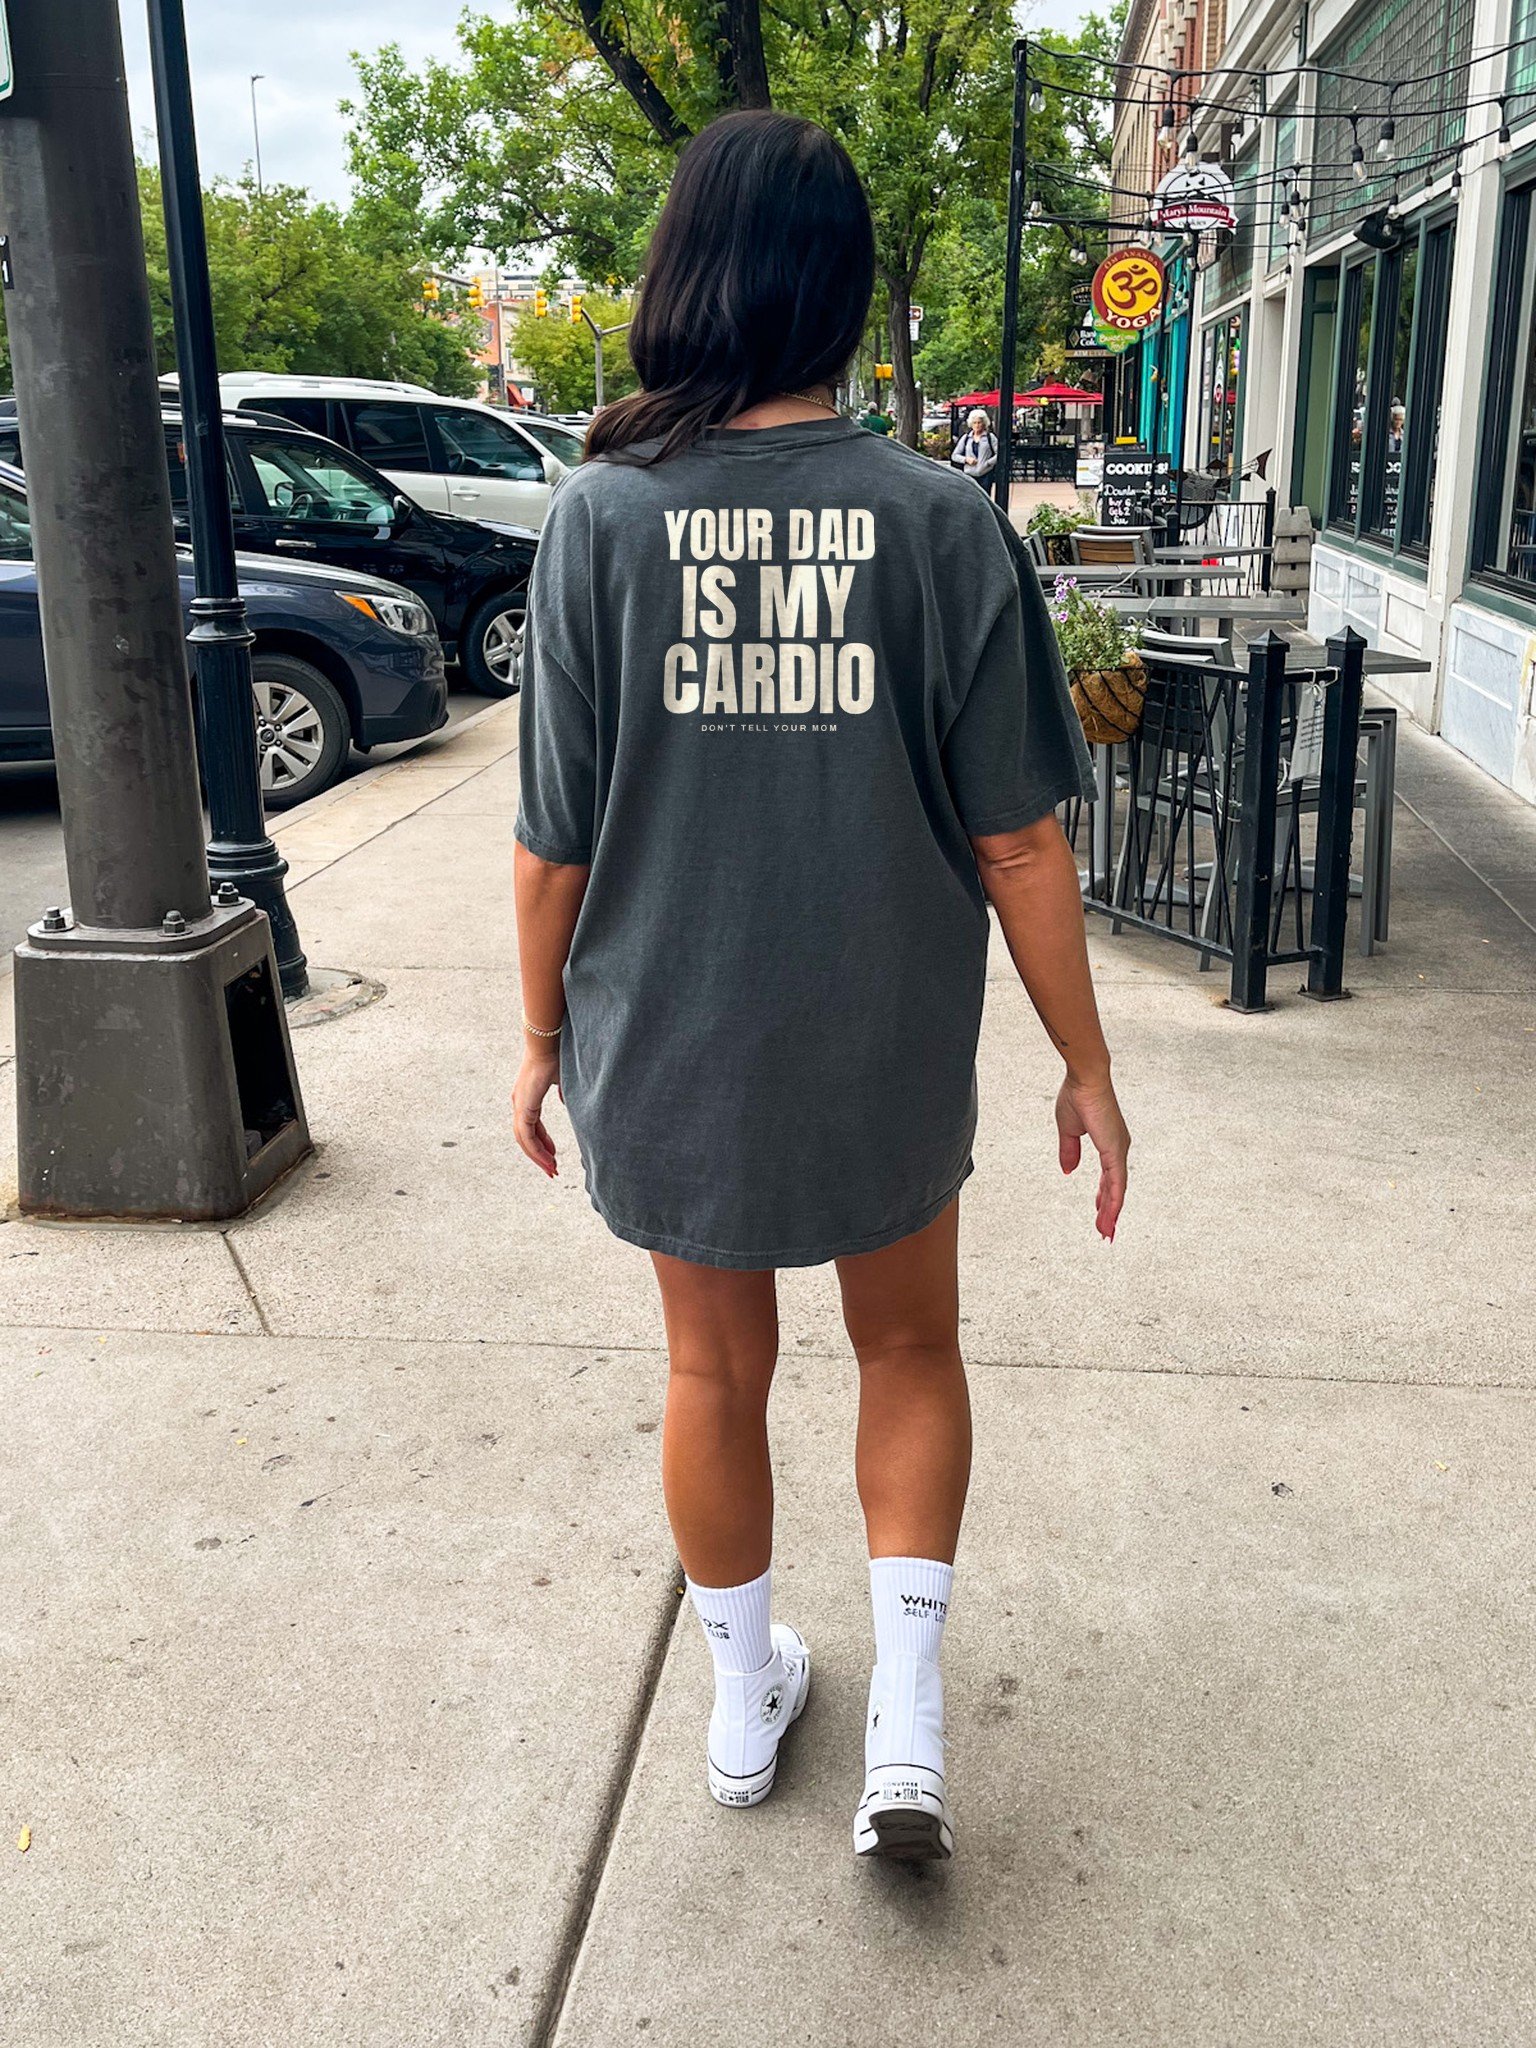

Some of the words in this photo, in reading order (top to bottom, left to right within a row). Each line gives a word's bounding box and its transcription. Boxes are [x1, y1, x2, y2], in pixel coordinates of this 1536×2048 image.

[1188, 204, 1227, 218] Mountain
[1104, 256, 1119, 269] OM
[1106, 303, 1163, 329] YOGA
[664, 508, 773, 561] YOUR
[788, 508, 876, 561] DAD
[681, 564, 737, 639] IS
[759, 564, 856, 639] MY
[663, 642, 876, 715] CARDIO
[701, 724, 736, 732] DON'T
[740, 724, 769, 732] TELL
[773, 724, 807, 732] YOUR
[811, 724, 838, 732] MOM
[903, 1607, 930, 1619] SELF
[903, 1788, 919, 1800] STAR
